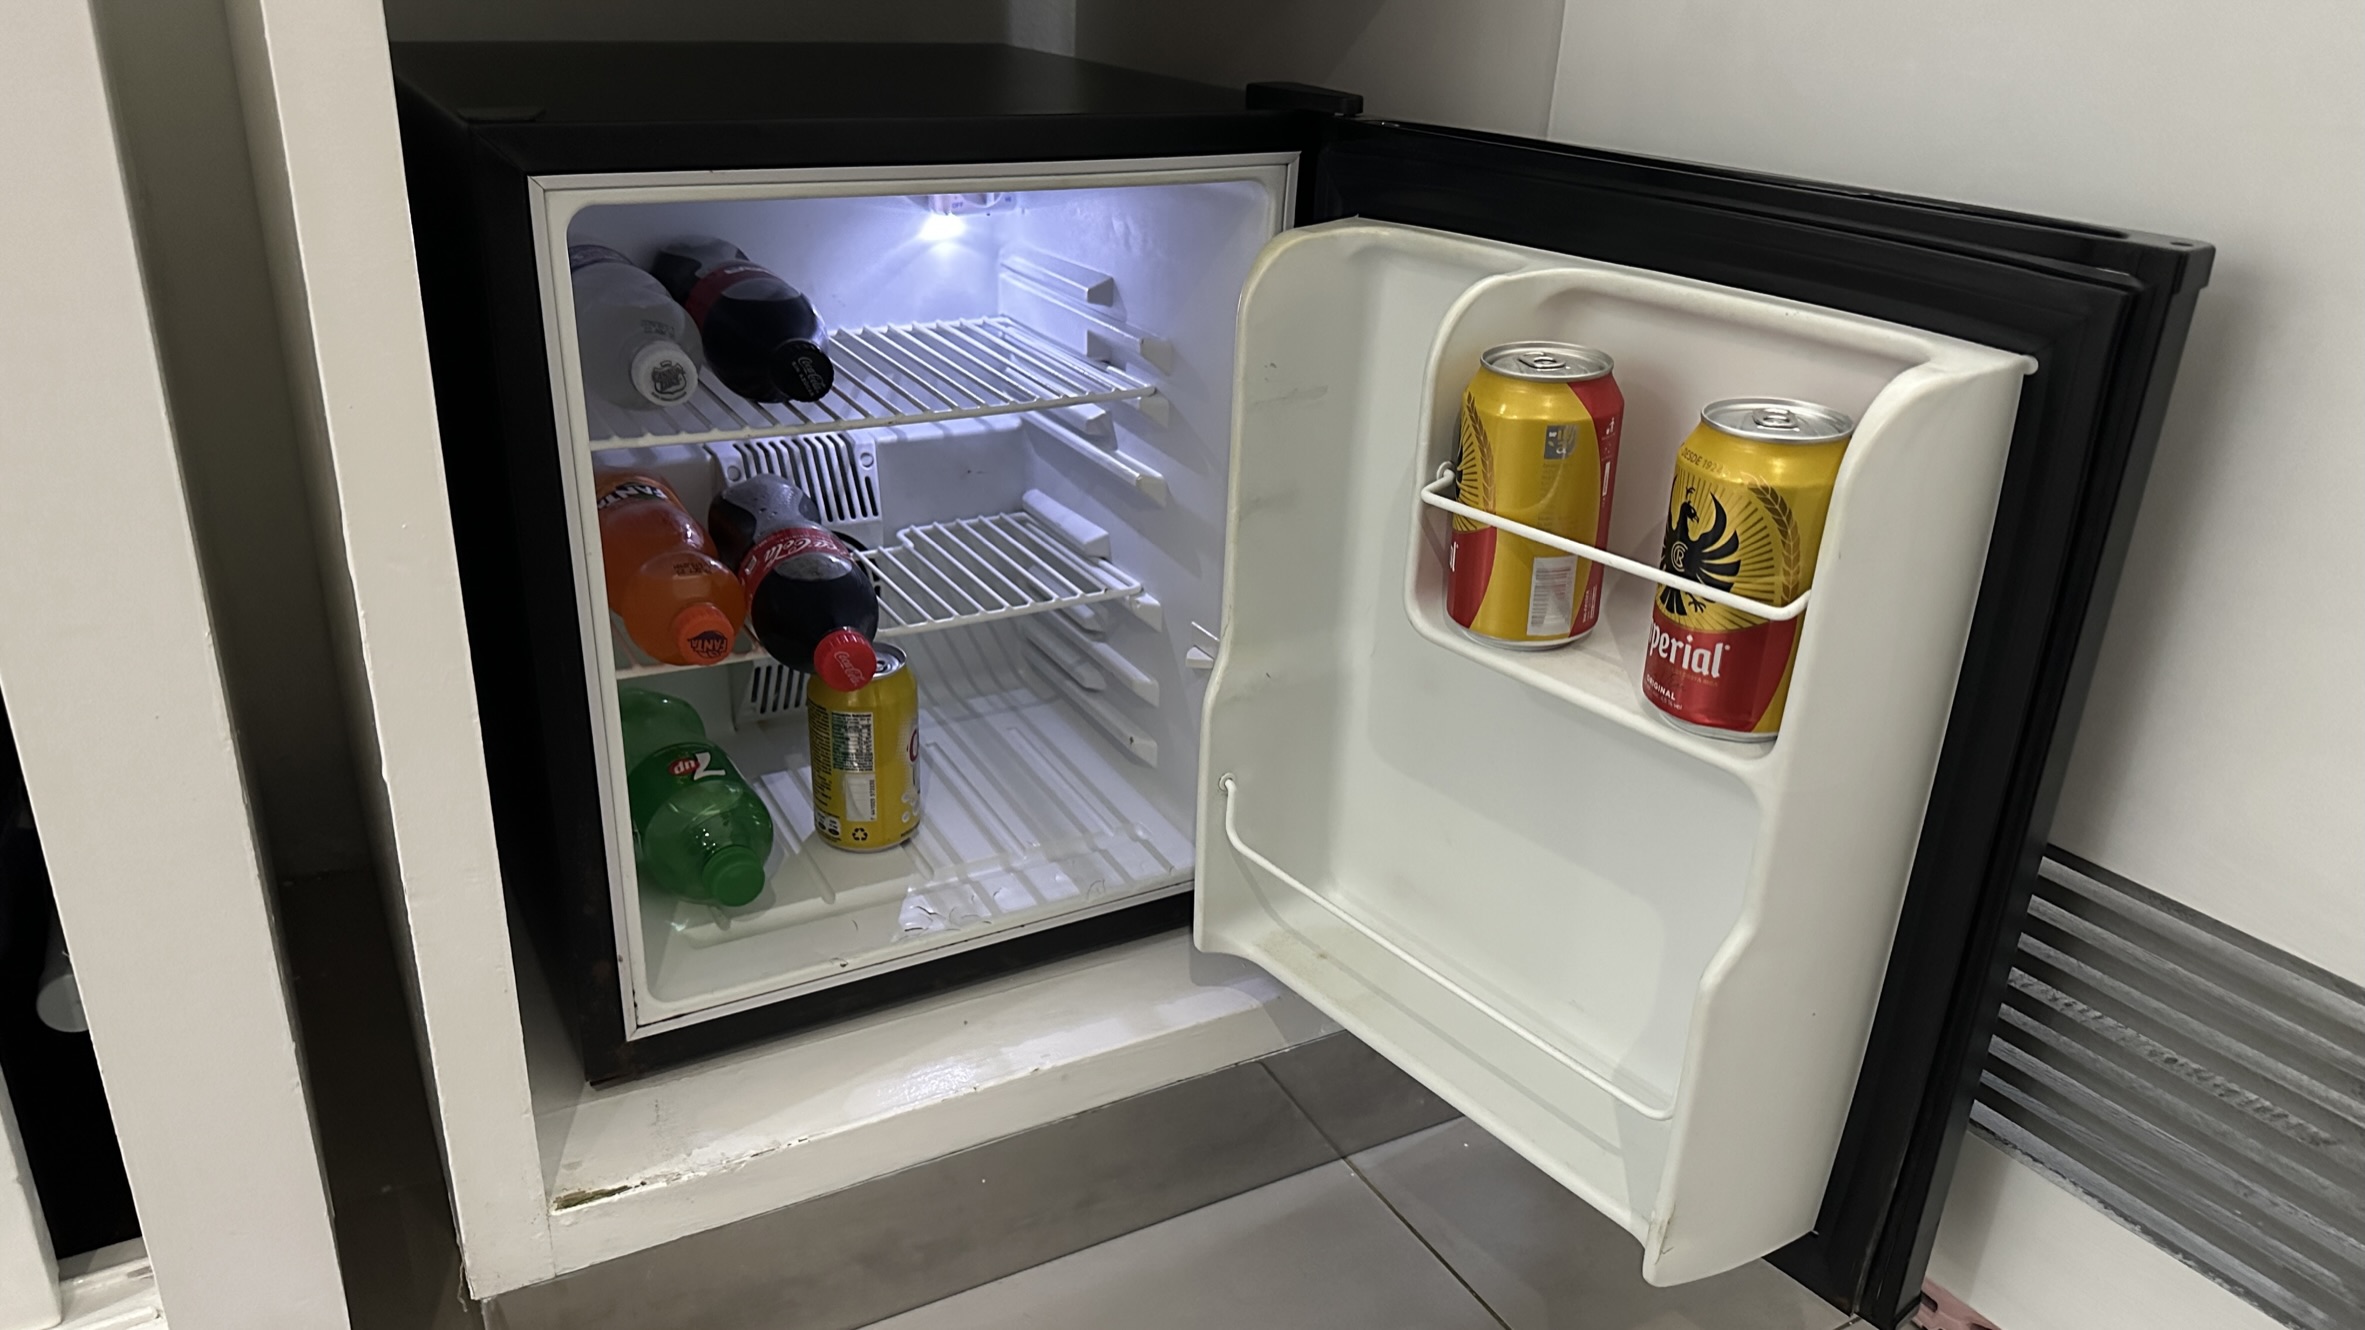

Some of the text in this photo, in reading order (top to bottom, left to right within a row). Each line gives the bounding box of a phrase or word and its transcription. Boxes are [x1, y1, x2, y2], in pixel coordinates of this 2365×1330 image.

[1681, 447, 1703, 466] DESDE
[691, 638, 727, 653] FANTA
[1649, 622, 1724, 679] perial
[833, 651, 866, 687] Coca-Cola
[1646, 673, 1676, 701] ORIGINAL
